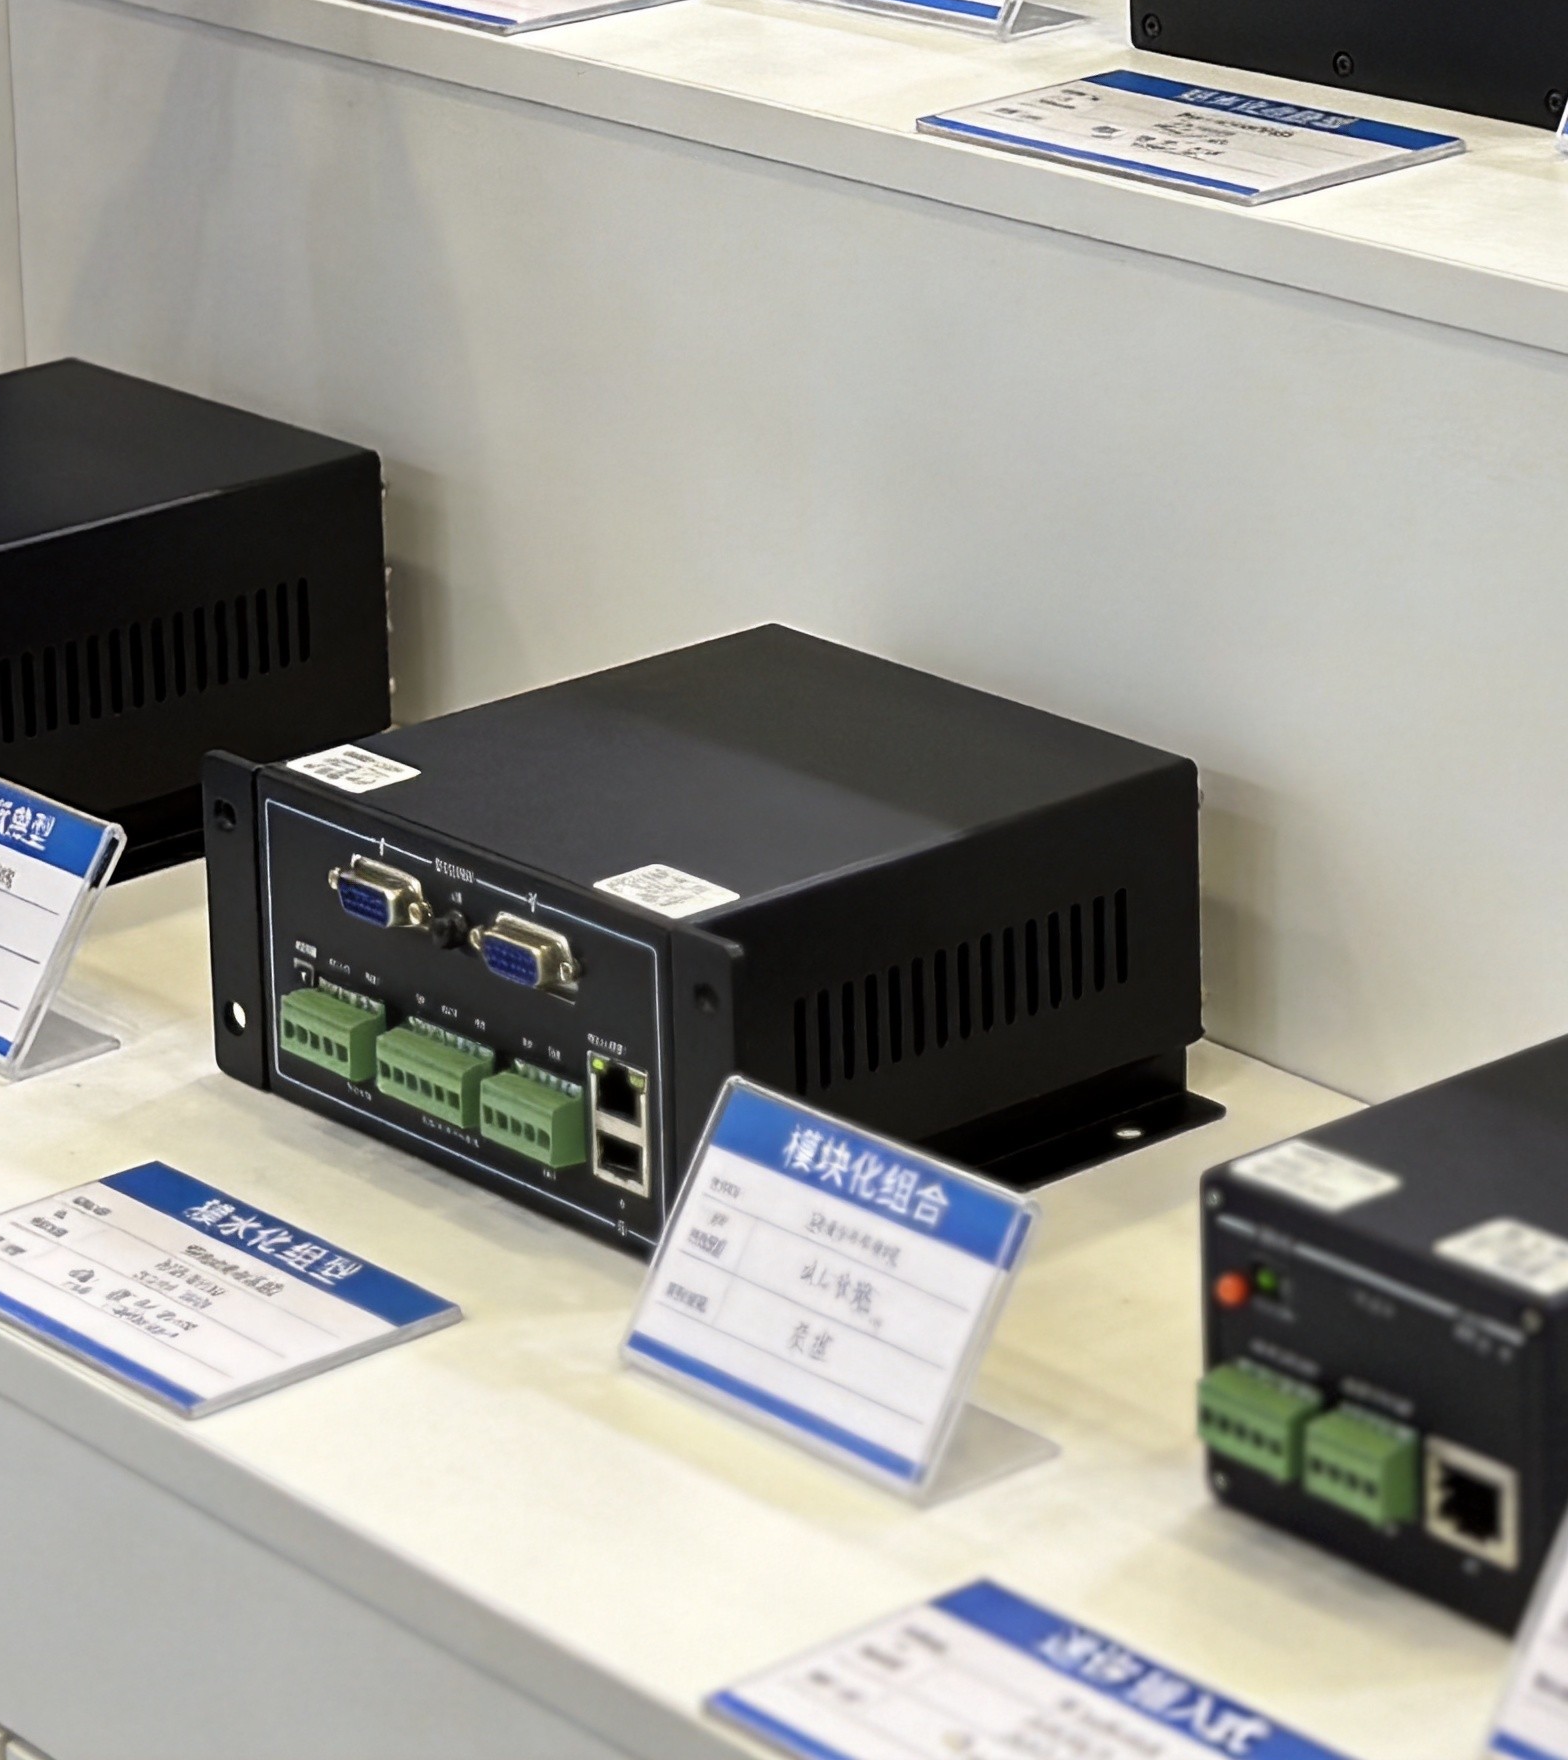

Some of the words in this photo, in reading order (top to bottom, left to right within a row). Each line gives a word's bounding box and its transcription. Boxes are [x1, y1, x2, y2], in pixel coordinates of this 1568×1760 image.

[783, 1125, 951, 1225] 模块化组合
